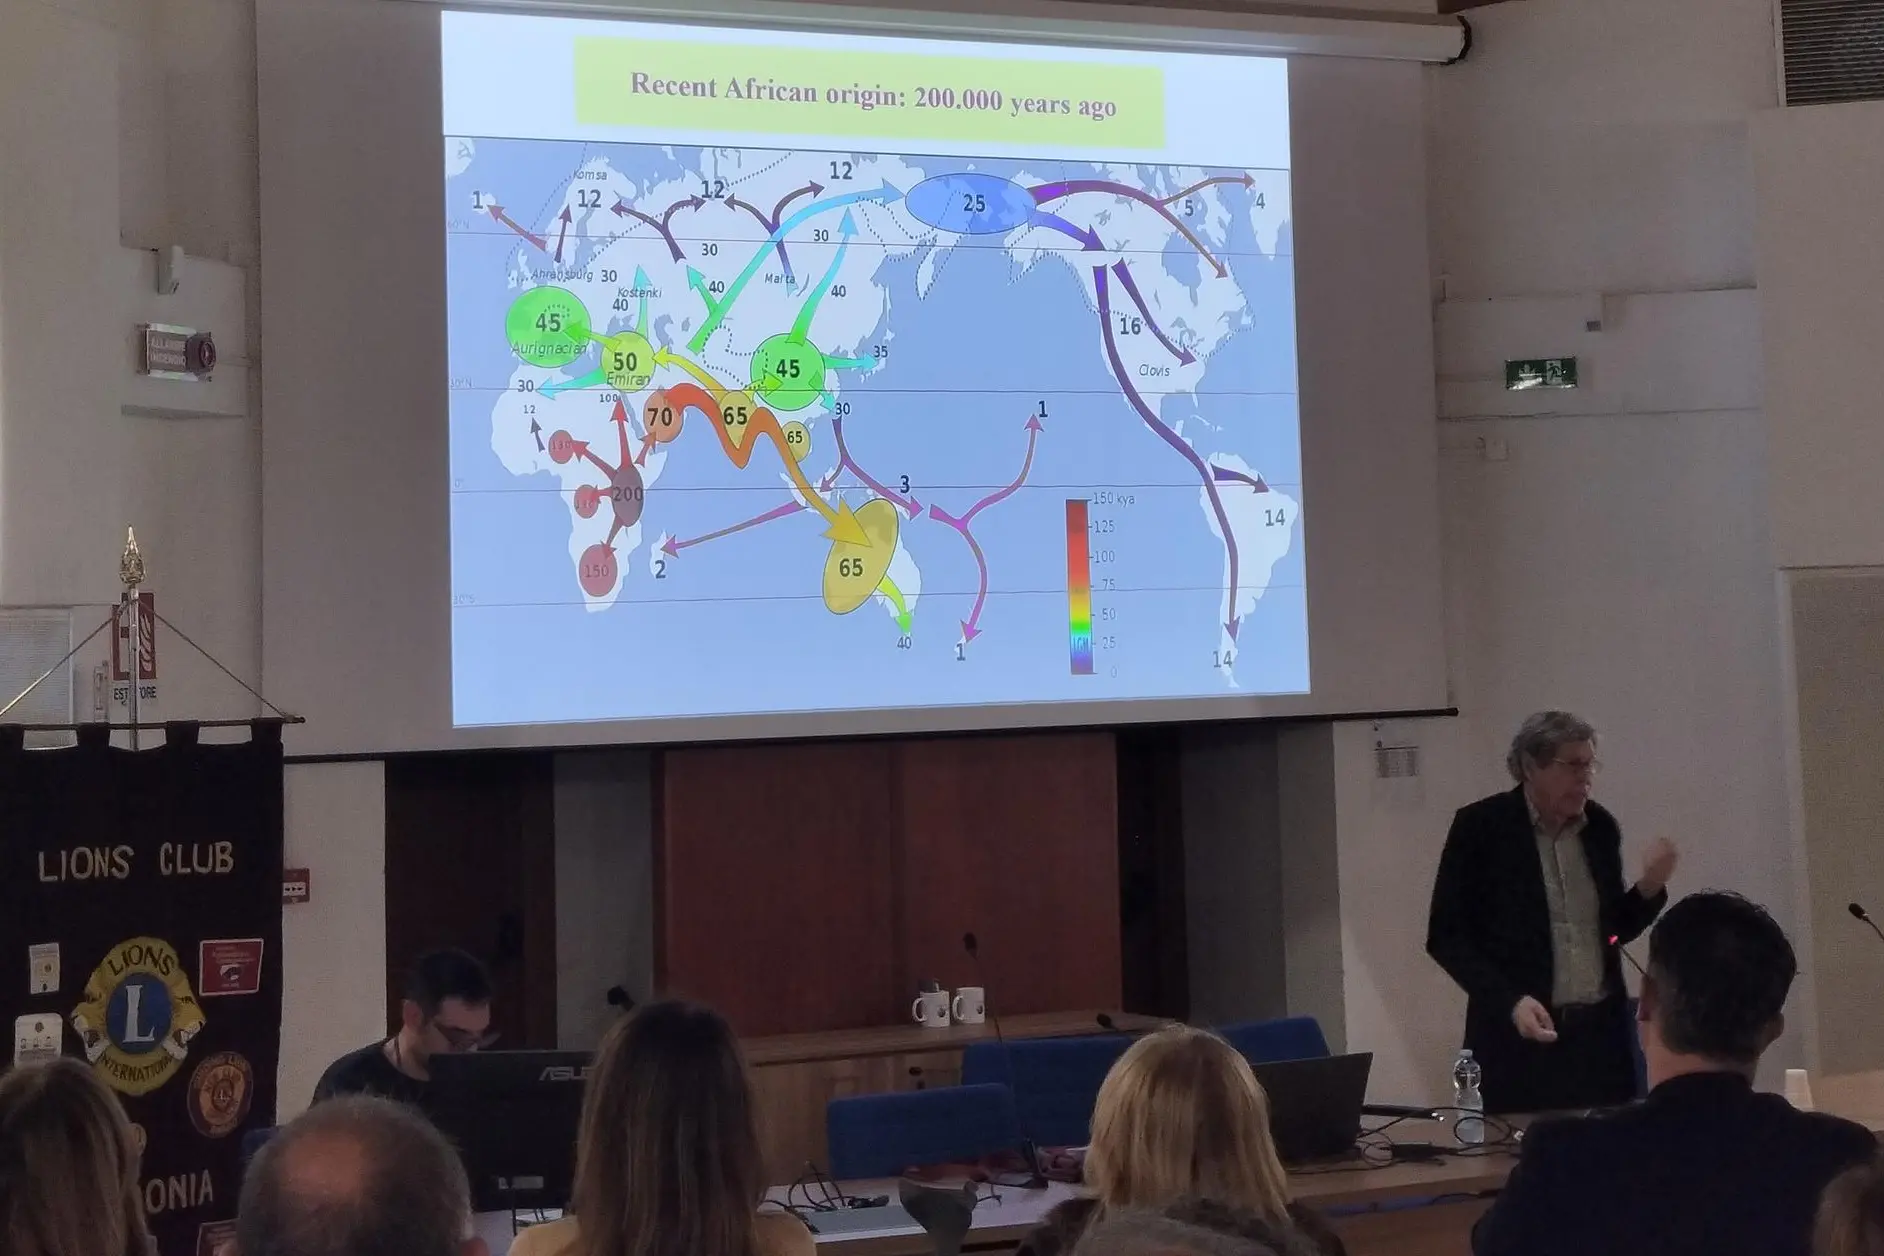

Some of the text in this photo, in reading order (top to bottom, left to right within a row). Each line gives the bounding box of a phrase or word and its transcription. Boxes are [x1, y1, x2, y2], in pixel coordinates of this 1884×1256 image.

[631, 72, 1117, 121] Recent African origin: 200.000 years ago
[573, 168, 608, 181] Komsa
[829, 162, 853, 180] 12
[701, 181, 725, 199] 12
[472, 192, 484, 209] 1
[577, 189, 602, 208] 12
[962, 193, 986, 213] 25
[1256, 192, 1266, 209] 4
[1184, 200, 1194, 217] 5
[813, 229, 829, 243] 30
[701, 243, 718, 257] 30
[601, 270, 617, 284] 30
[617, 287, 662, 299] Kostenki
[708, 280, 725, 294] 40
[831, 285, 847, 299] 40
[612, 299, 629, 313] 40
[535, 313, 562, 333] 45
[1119, 317, 1142, 336] 16
[511, 342, 588, 358] Aurignacian
[873, 346, 889, 359] 35
[613, 352, 637, 372] 50
[776, 359, 800, 379] 45
[1138, 363, 1170, 377] Clovis
[517, 379, 534, 393] 30
[606, 371, 650, 386] Emiran
[600, 393, 618, 403] 100
[524, 405, 536, 414] 12
[723, 406, 748, 426] 65
[835, 402, 851, 416] 30
[1038, 400, 1048, 418] 1
[647, 407, 673, 427] 70
[787, 430, 803, 444] 65
[900, 474, 911, 494] 3
[612, 486, 643, 501] 200
[1093, 492, 1135, 505] 150 kya
[1264, 508, 1286, 527] 14
[1094, 519, 1115, 533] 125
[1094, 550, 1115, 563] 100
[585, 565, 609, 578] 150
[654, 560, 666, 579] 2
[839, 558, 863, 577] 65
[1102, 578, 1116, 591] 75
[1102, 608, 1116, 621] 50
[897, 637, 912, 649] 40
[1102, 636, 1116, 649] 25
[956, 643, 966, 662] 1
[1212, 650, 1233, 668] 14
[113, 687, 157, 700] ESTORE
[38, 841, 235, 882] LIONS CLUB
[107, 944, 176, 977] LIONS
[122, 984, 155, 1042] L
